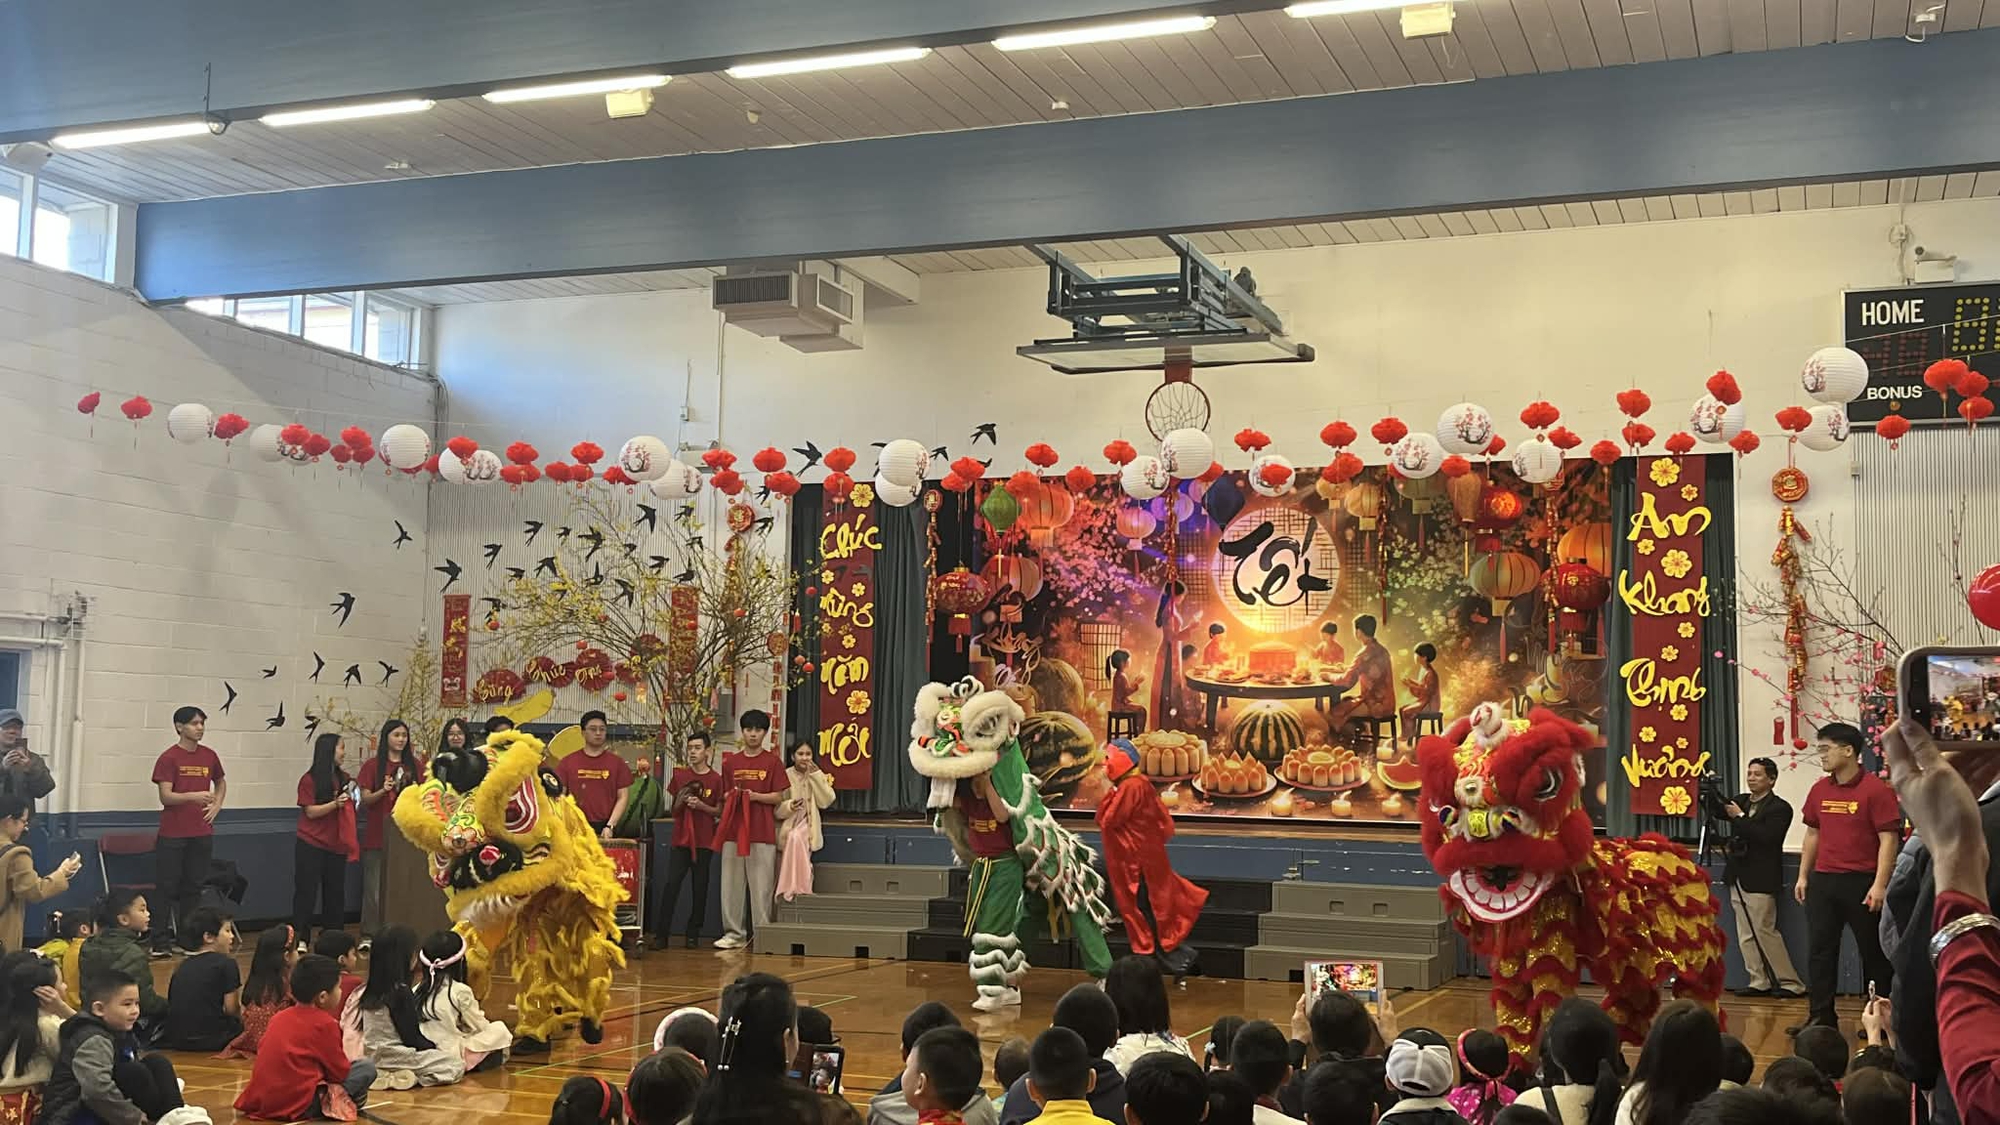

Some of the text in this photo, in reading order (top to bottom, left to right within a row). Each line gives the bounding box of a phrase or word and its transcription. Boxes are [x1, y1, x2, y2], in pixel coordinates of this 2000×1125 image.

[1861, 299, 1925, 326] HOME
[1866, 385, 1923, 400] BONUS
[819, 513, 883, 559] Chúc
[1626, 492, 1712, 541] An
[1618, 569, 1711, 617] Khang
[1619, 657, 1707, 712] Thịnh
